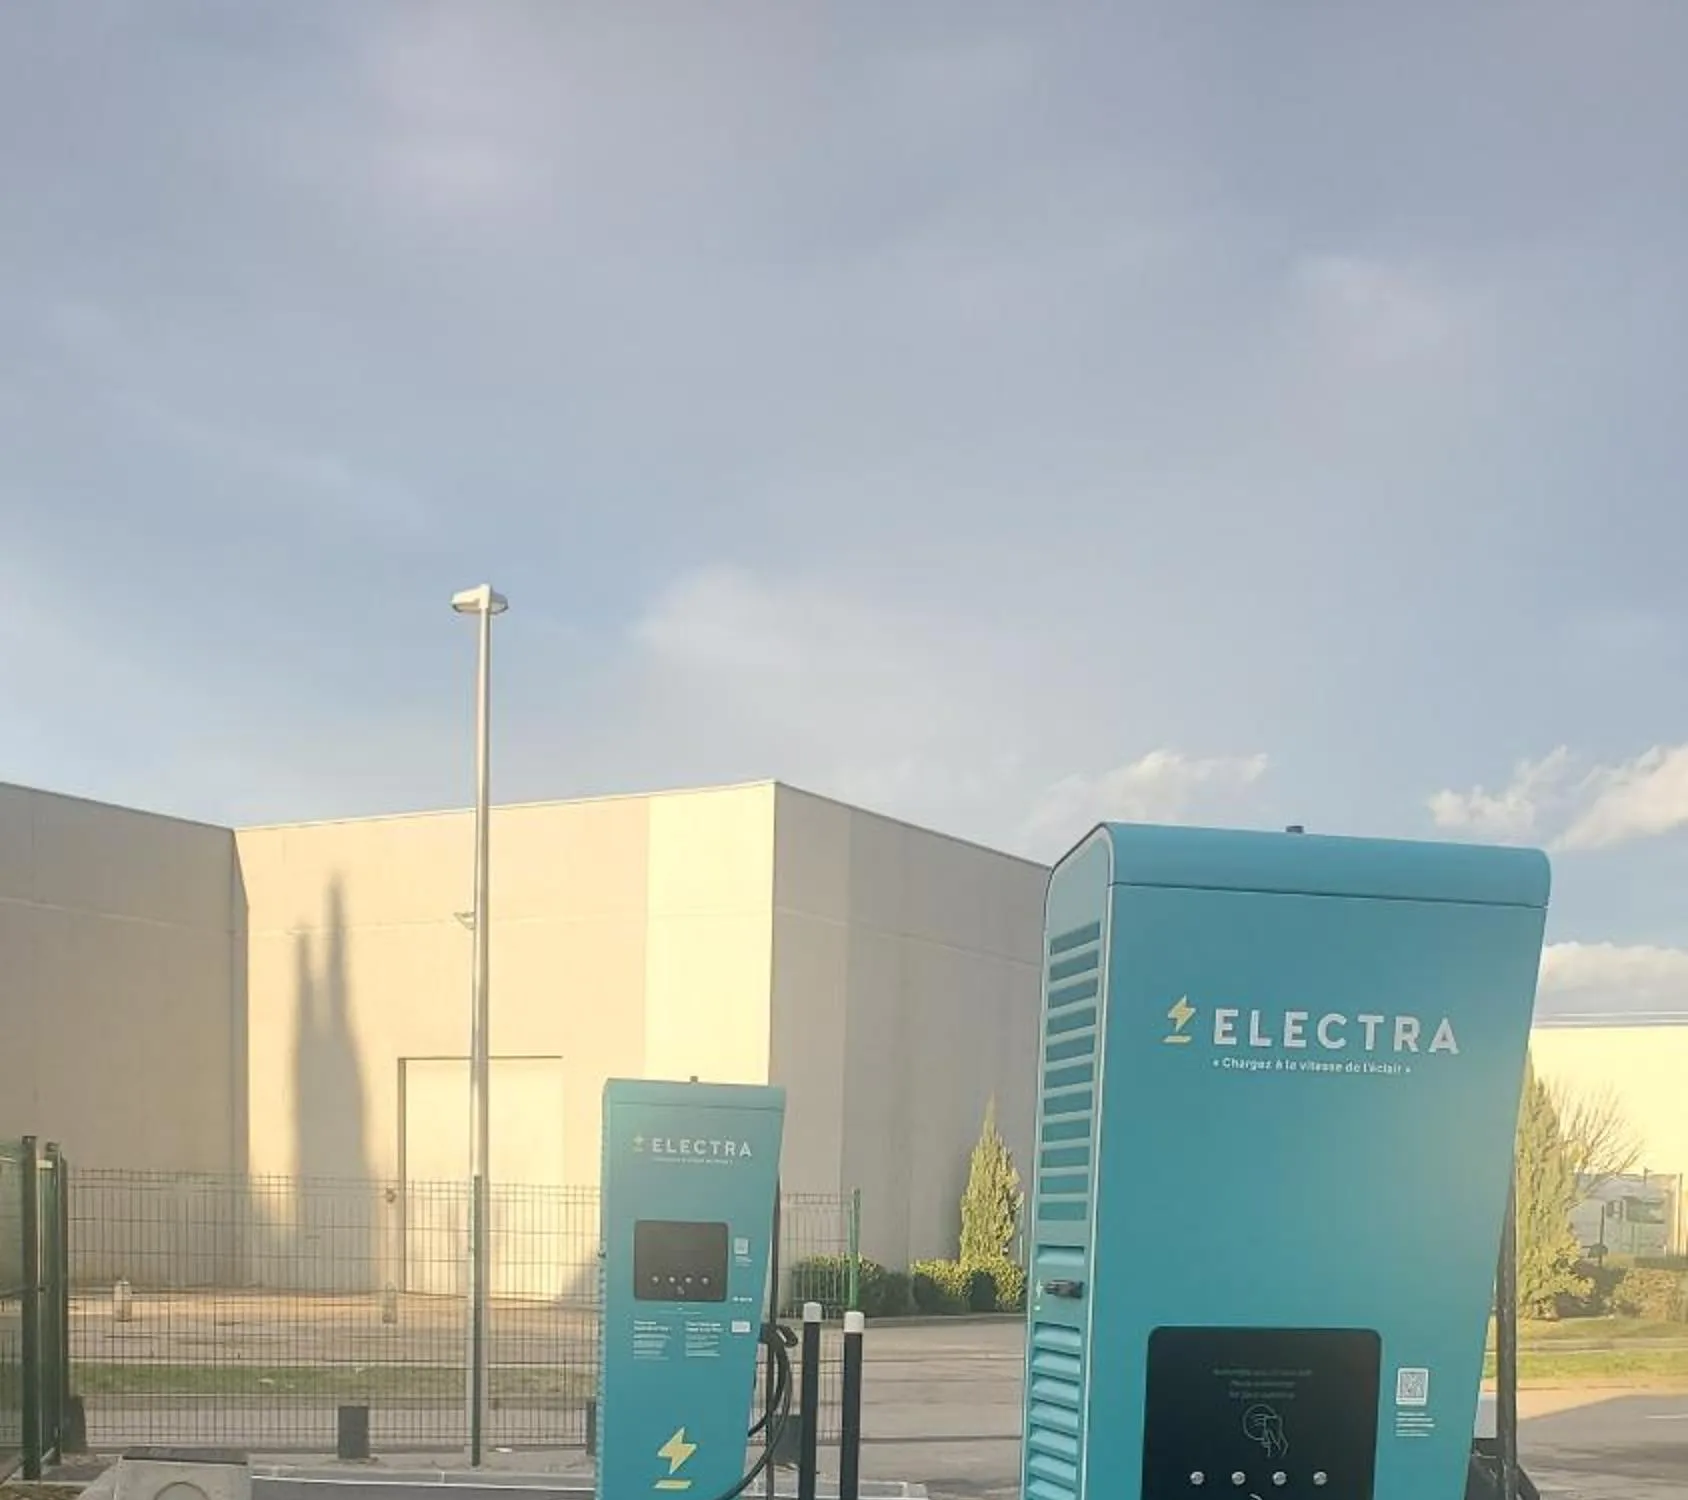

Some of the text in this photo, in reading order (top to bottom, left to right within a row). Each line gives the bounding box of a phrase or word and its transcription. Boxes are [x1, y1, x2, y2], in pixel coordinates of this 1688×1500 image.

[1213, 1008, 1460, 1055] ELECTRA
[1222, 1057, 1272, 1071] Chargez
[1285, 1059, 1297, 1069] la
[1299, 1060, 1343, 1072] vitesse
[1345, 1060, 1360, 1073] de
[652, 1137, 752, 1157] ELECTRA
